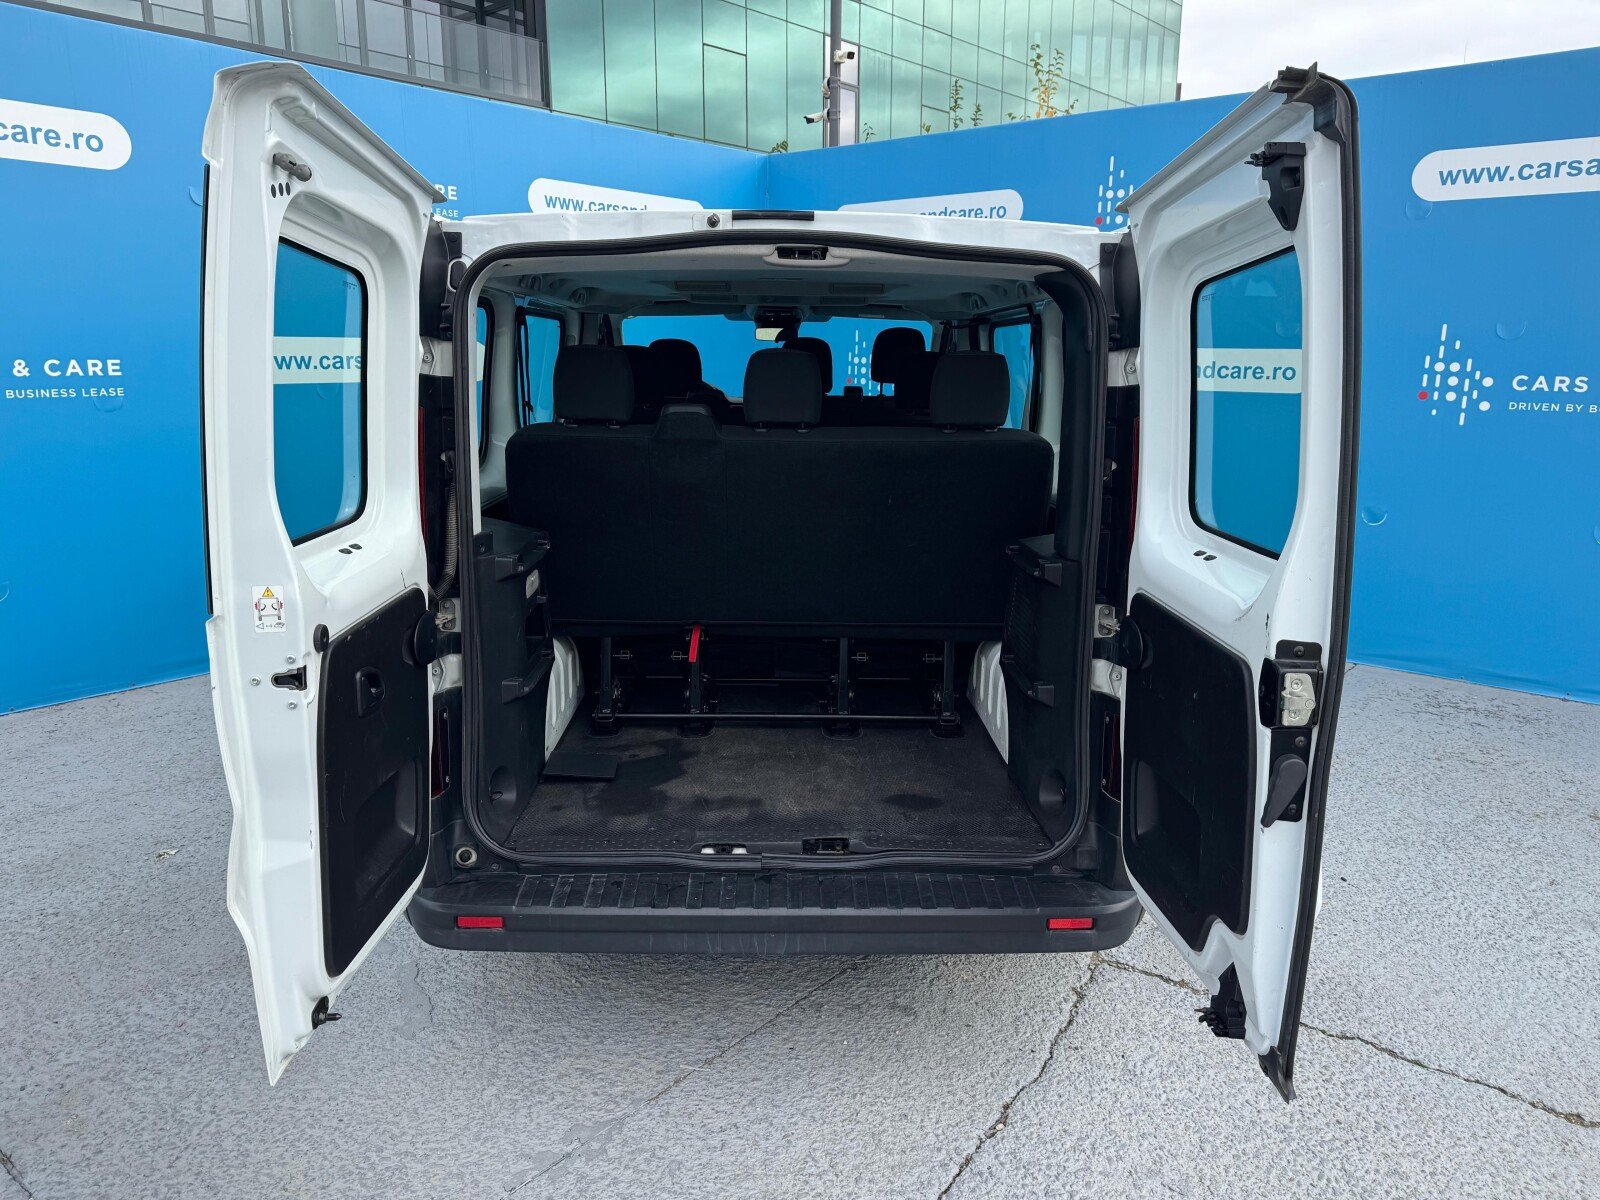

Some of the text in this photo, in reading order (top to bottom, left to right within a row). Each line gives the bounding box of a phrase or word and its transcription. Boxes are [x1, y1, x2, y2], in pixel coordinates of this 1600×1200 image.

[1438, 157, 1600, 186] www.carsa
[12, 359, 123, 377] & CARE
[1512, 374, 1589, 393] CARS
[5, 387, 125, 399] BUSINESS LEASE
[1508, 401, 1600, 413] DRIVEN BY B
